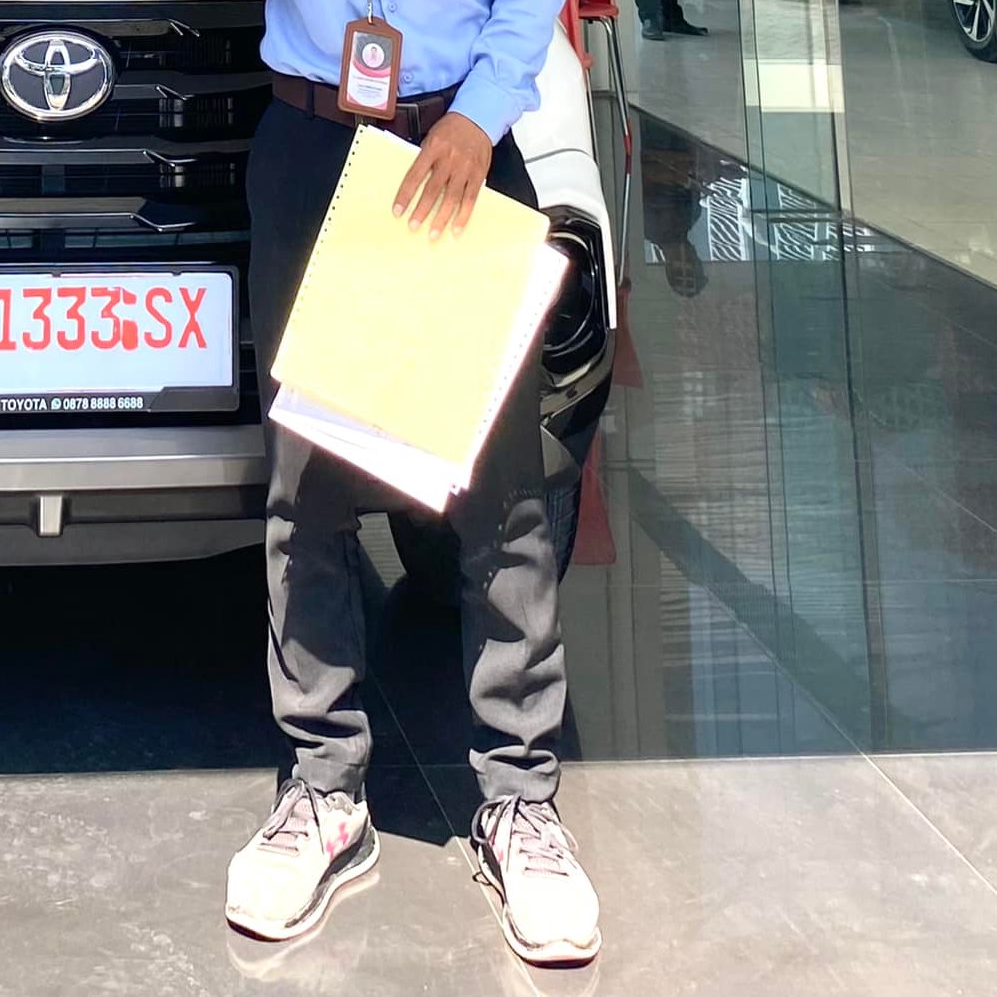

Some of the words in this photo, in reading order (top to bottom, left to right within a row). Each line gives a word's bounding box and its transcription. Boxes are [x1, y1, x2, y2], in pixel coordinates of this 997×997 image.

[144, 287, 208, 350] SX
[0, 397, 48, 412] TOYOTA
[63, 397, 89, 410] 0878
[90, 397, 117, 410] 8888
[117, 397, 144, 410] 6688
